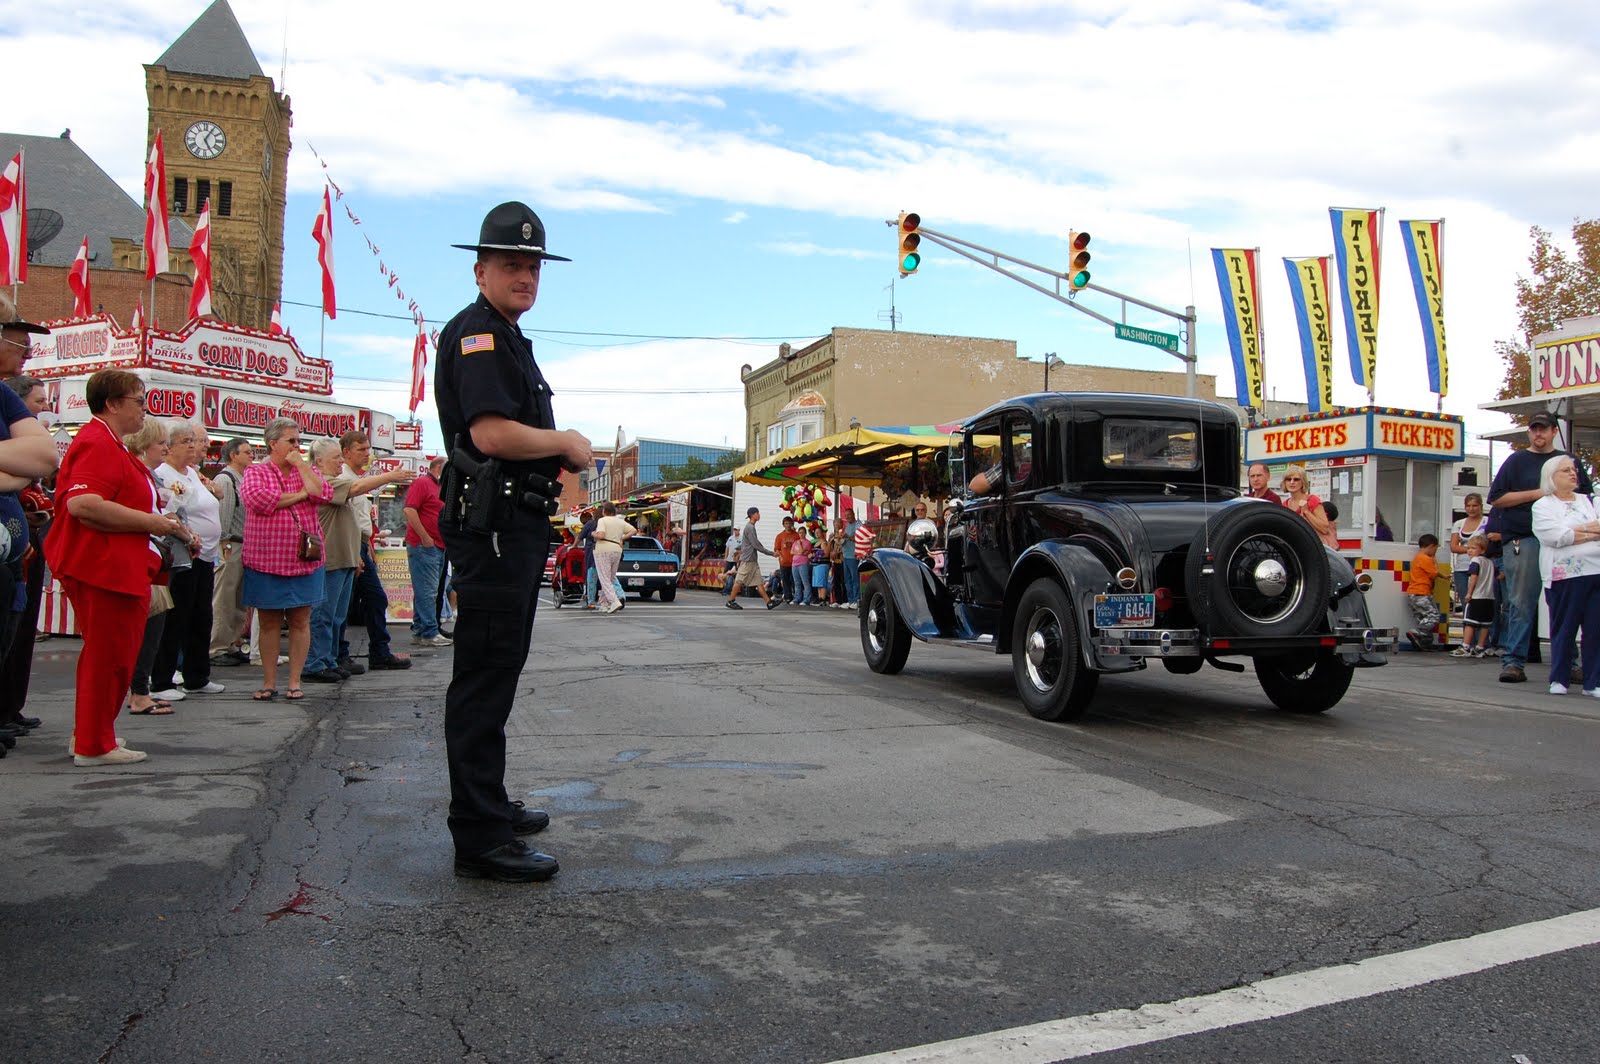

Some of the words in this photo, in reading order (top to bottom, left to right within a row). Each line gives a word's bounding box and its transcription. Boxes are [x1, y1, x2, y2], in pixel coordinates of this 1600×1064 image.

[56, 328, 109, 360] VEGGIES
[243, 338, 268, 349] DIPPED
[1120, 327, 1168, 345] WASHINGTON
[113, 341, 134, 349] LEMON
[154, 349, 194, 361] DRINKS
[198, 342, 244, 369] CORN
[245, 349, 288, 376] DOGS
[295, 366, 323, 375] LEMON
[67, 394, 88, 409] Frie
[281, 399, 305, 410] Fried
[223, 396, 277, 428] GREEN
[1263, 422, 1348, 453] TICKETS
[1380, 420, 1455, 450] TICKETS
[1125, 602, 1151, 618] 6454
